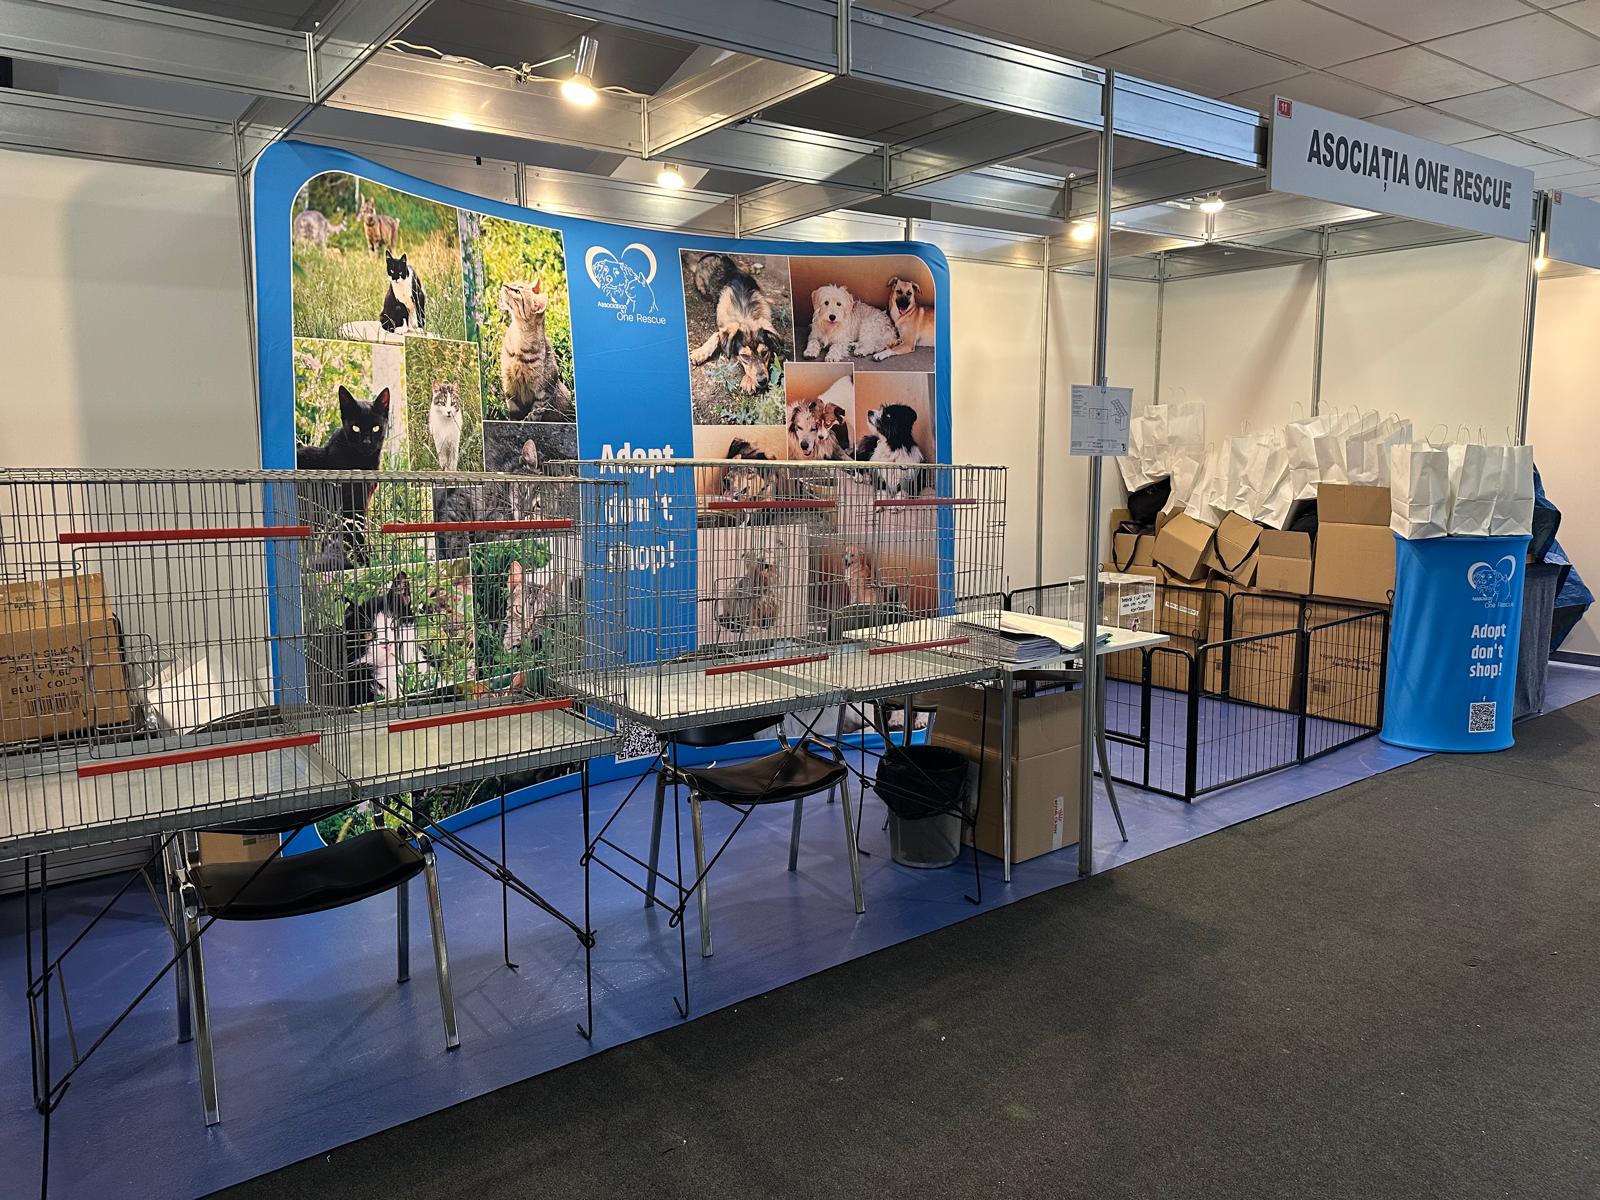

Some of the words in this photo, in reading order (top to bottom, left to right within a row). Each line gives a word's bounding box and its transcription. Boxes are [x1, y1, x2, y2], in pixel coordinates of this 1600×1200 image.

[1307, 129, 1409, 192] ASOCIAȚIA
[1415, 157, 1449, 195] ONE
[1453, 167, 1512, 210] RESCUE
[616, 311, 634, 322] One
[636, 313, 666, 325] Rescue
[600, 442, 675, 479] Adopt
[604, 489, 673, 524] don't
[1471, 623, 1507, 640] Adopt
[1471, 643, 1504, 659] don't
[1469, 662, 1503, 679] shop!
